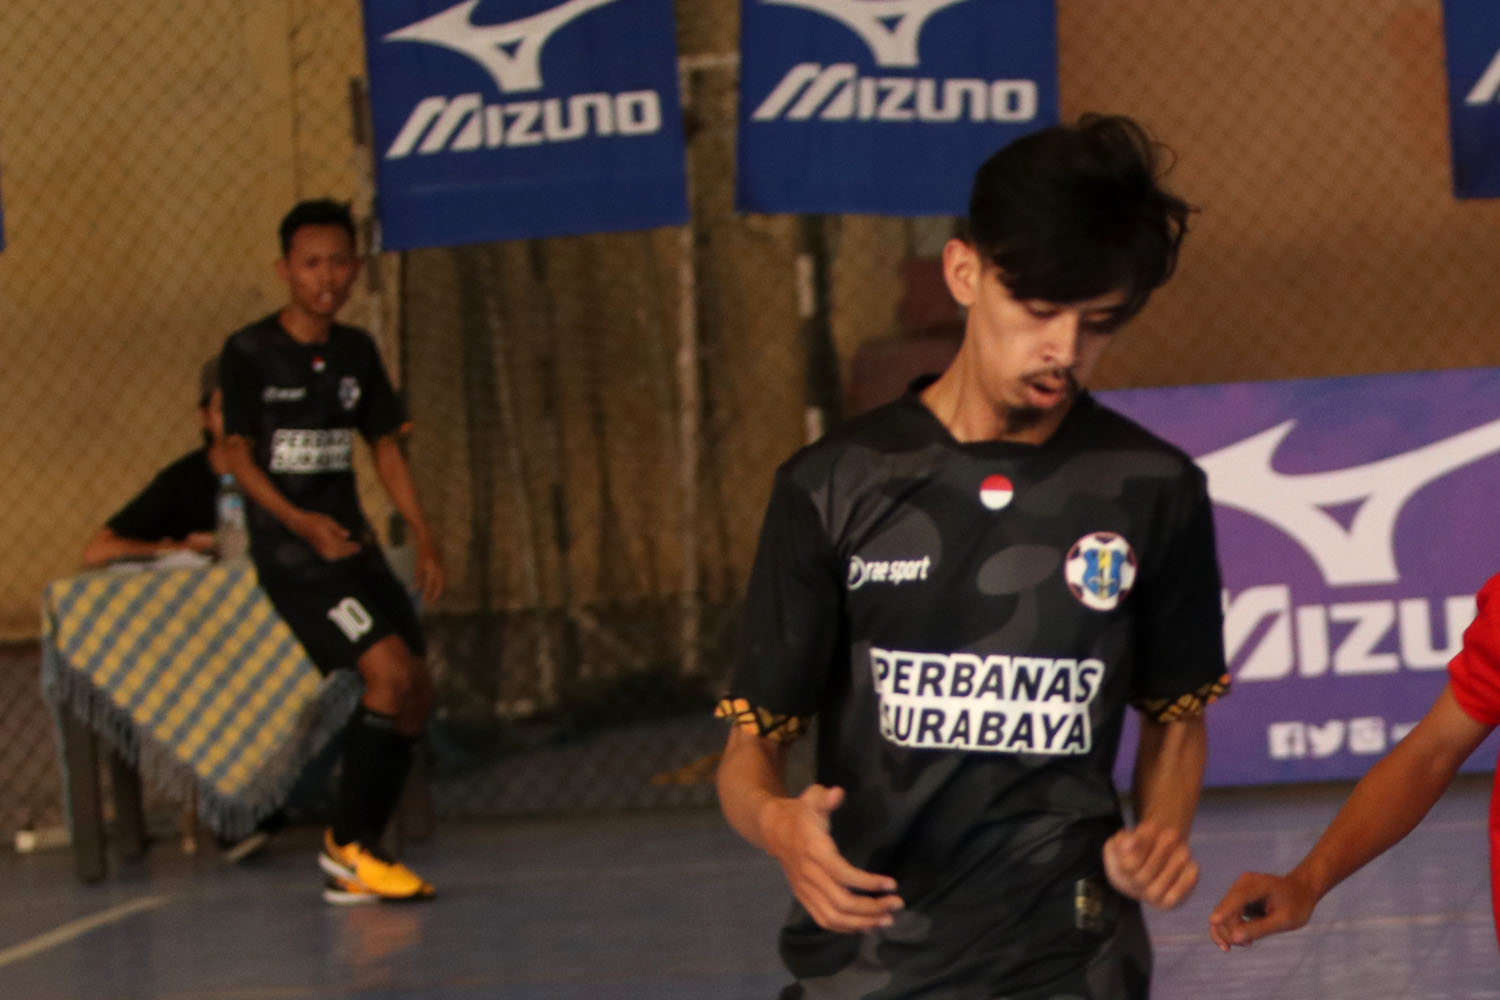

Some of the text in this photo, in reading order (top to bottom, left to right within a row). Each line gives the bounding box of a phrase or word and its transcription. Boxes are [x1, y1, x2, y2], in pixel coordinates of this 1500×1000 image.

[751, 62, 1037, 122] MIZUNO
[385, 90, 661, 160] MIZUNO
[327, 597, 373, 643] 10
[872, 656, 1100, 703] PERBANAS
